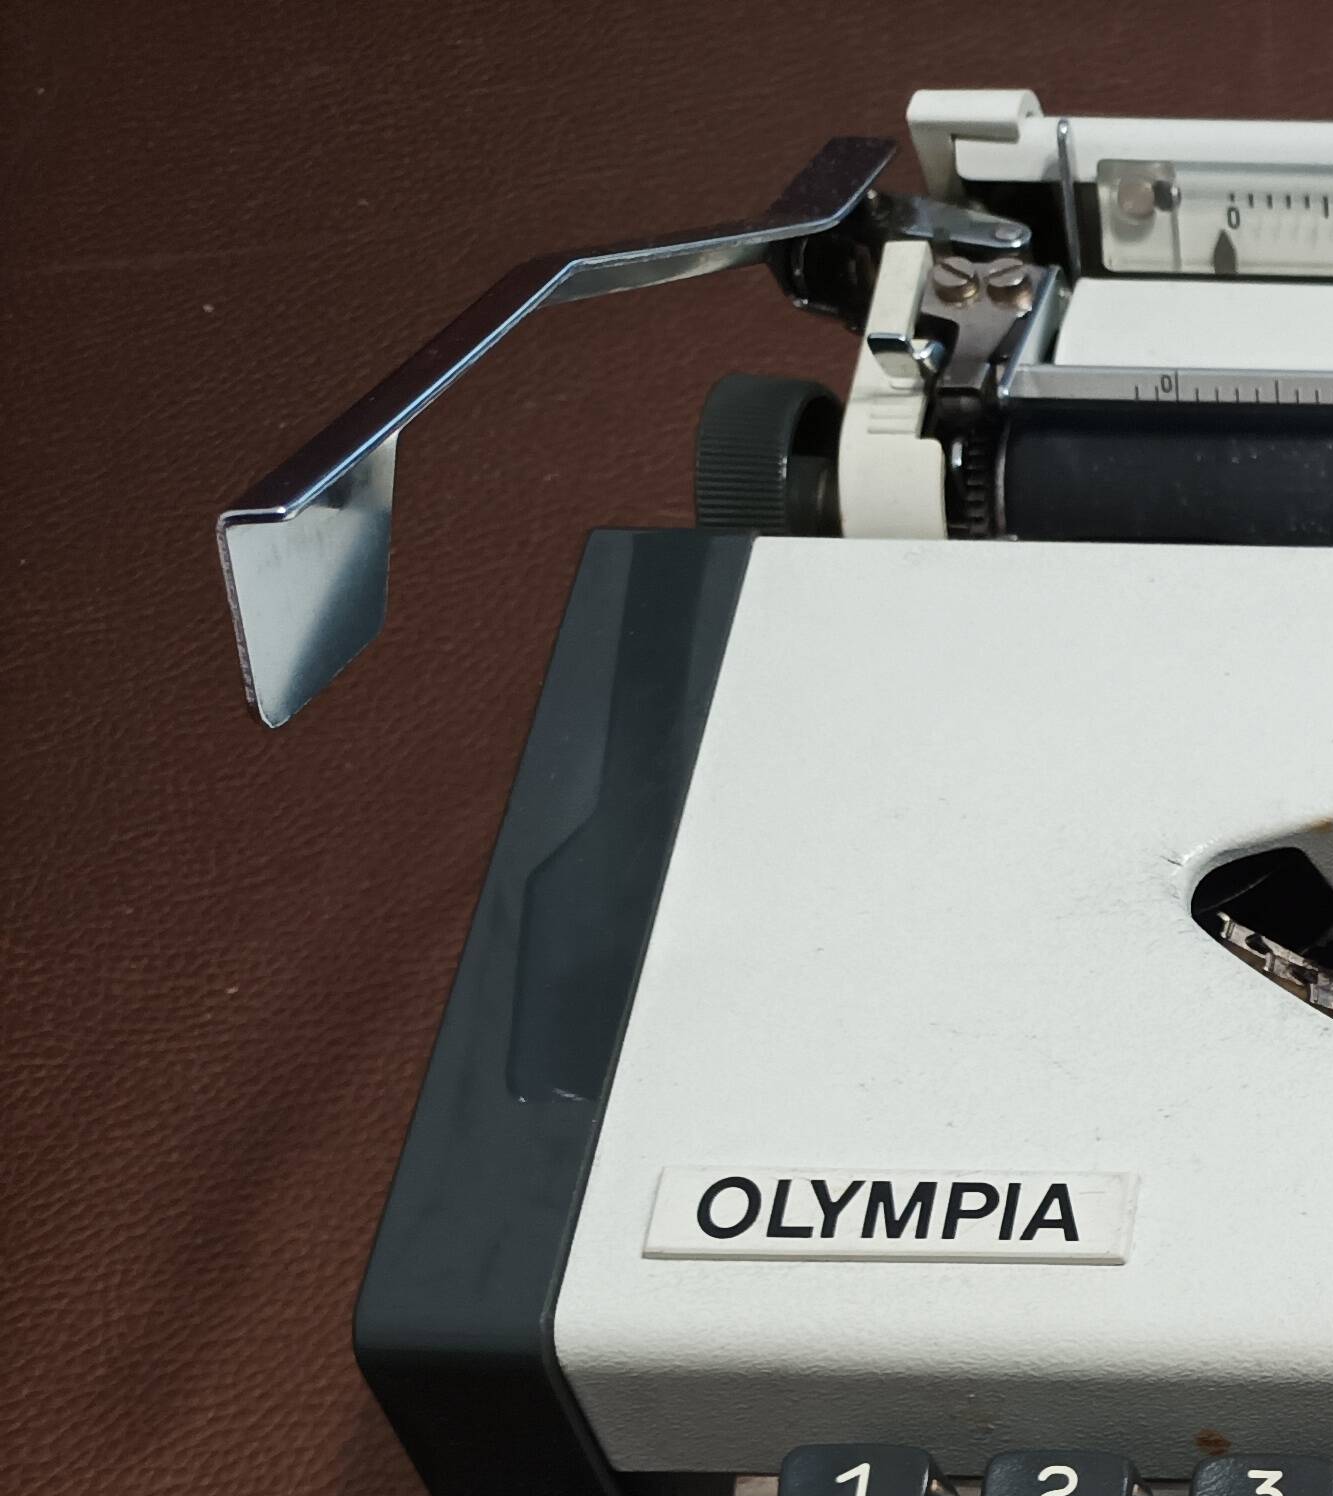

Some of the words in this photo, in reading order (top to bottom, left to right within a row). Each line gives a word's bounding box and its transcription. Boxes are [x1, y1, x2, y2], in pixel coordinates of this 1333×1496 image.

[1227, 206, 1240, 229] 0
[1160, 374, 1173, 394] 0
[696, 1176, 1079, 1241] OLYMPIA
